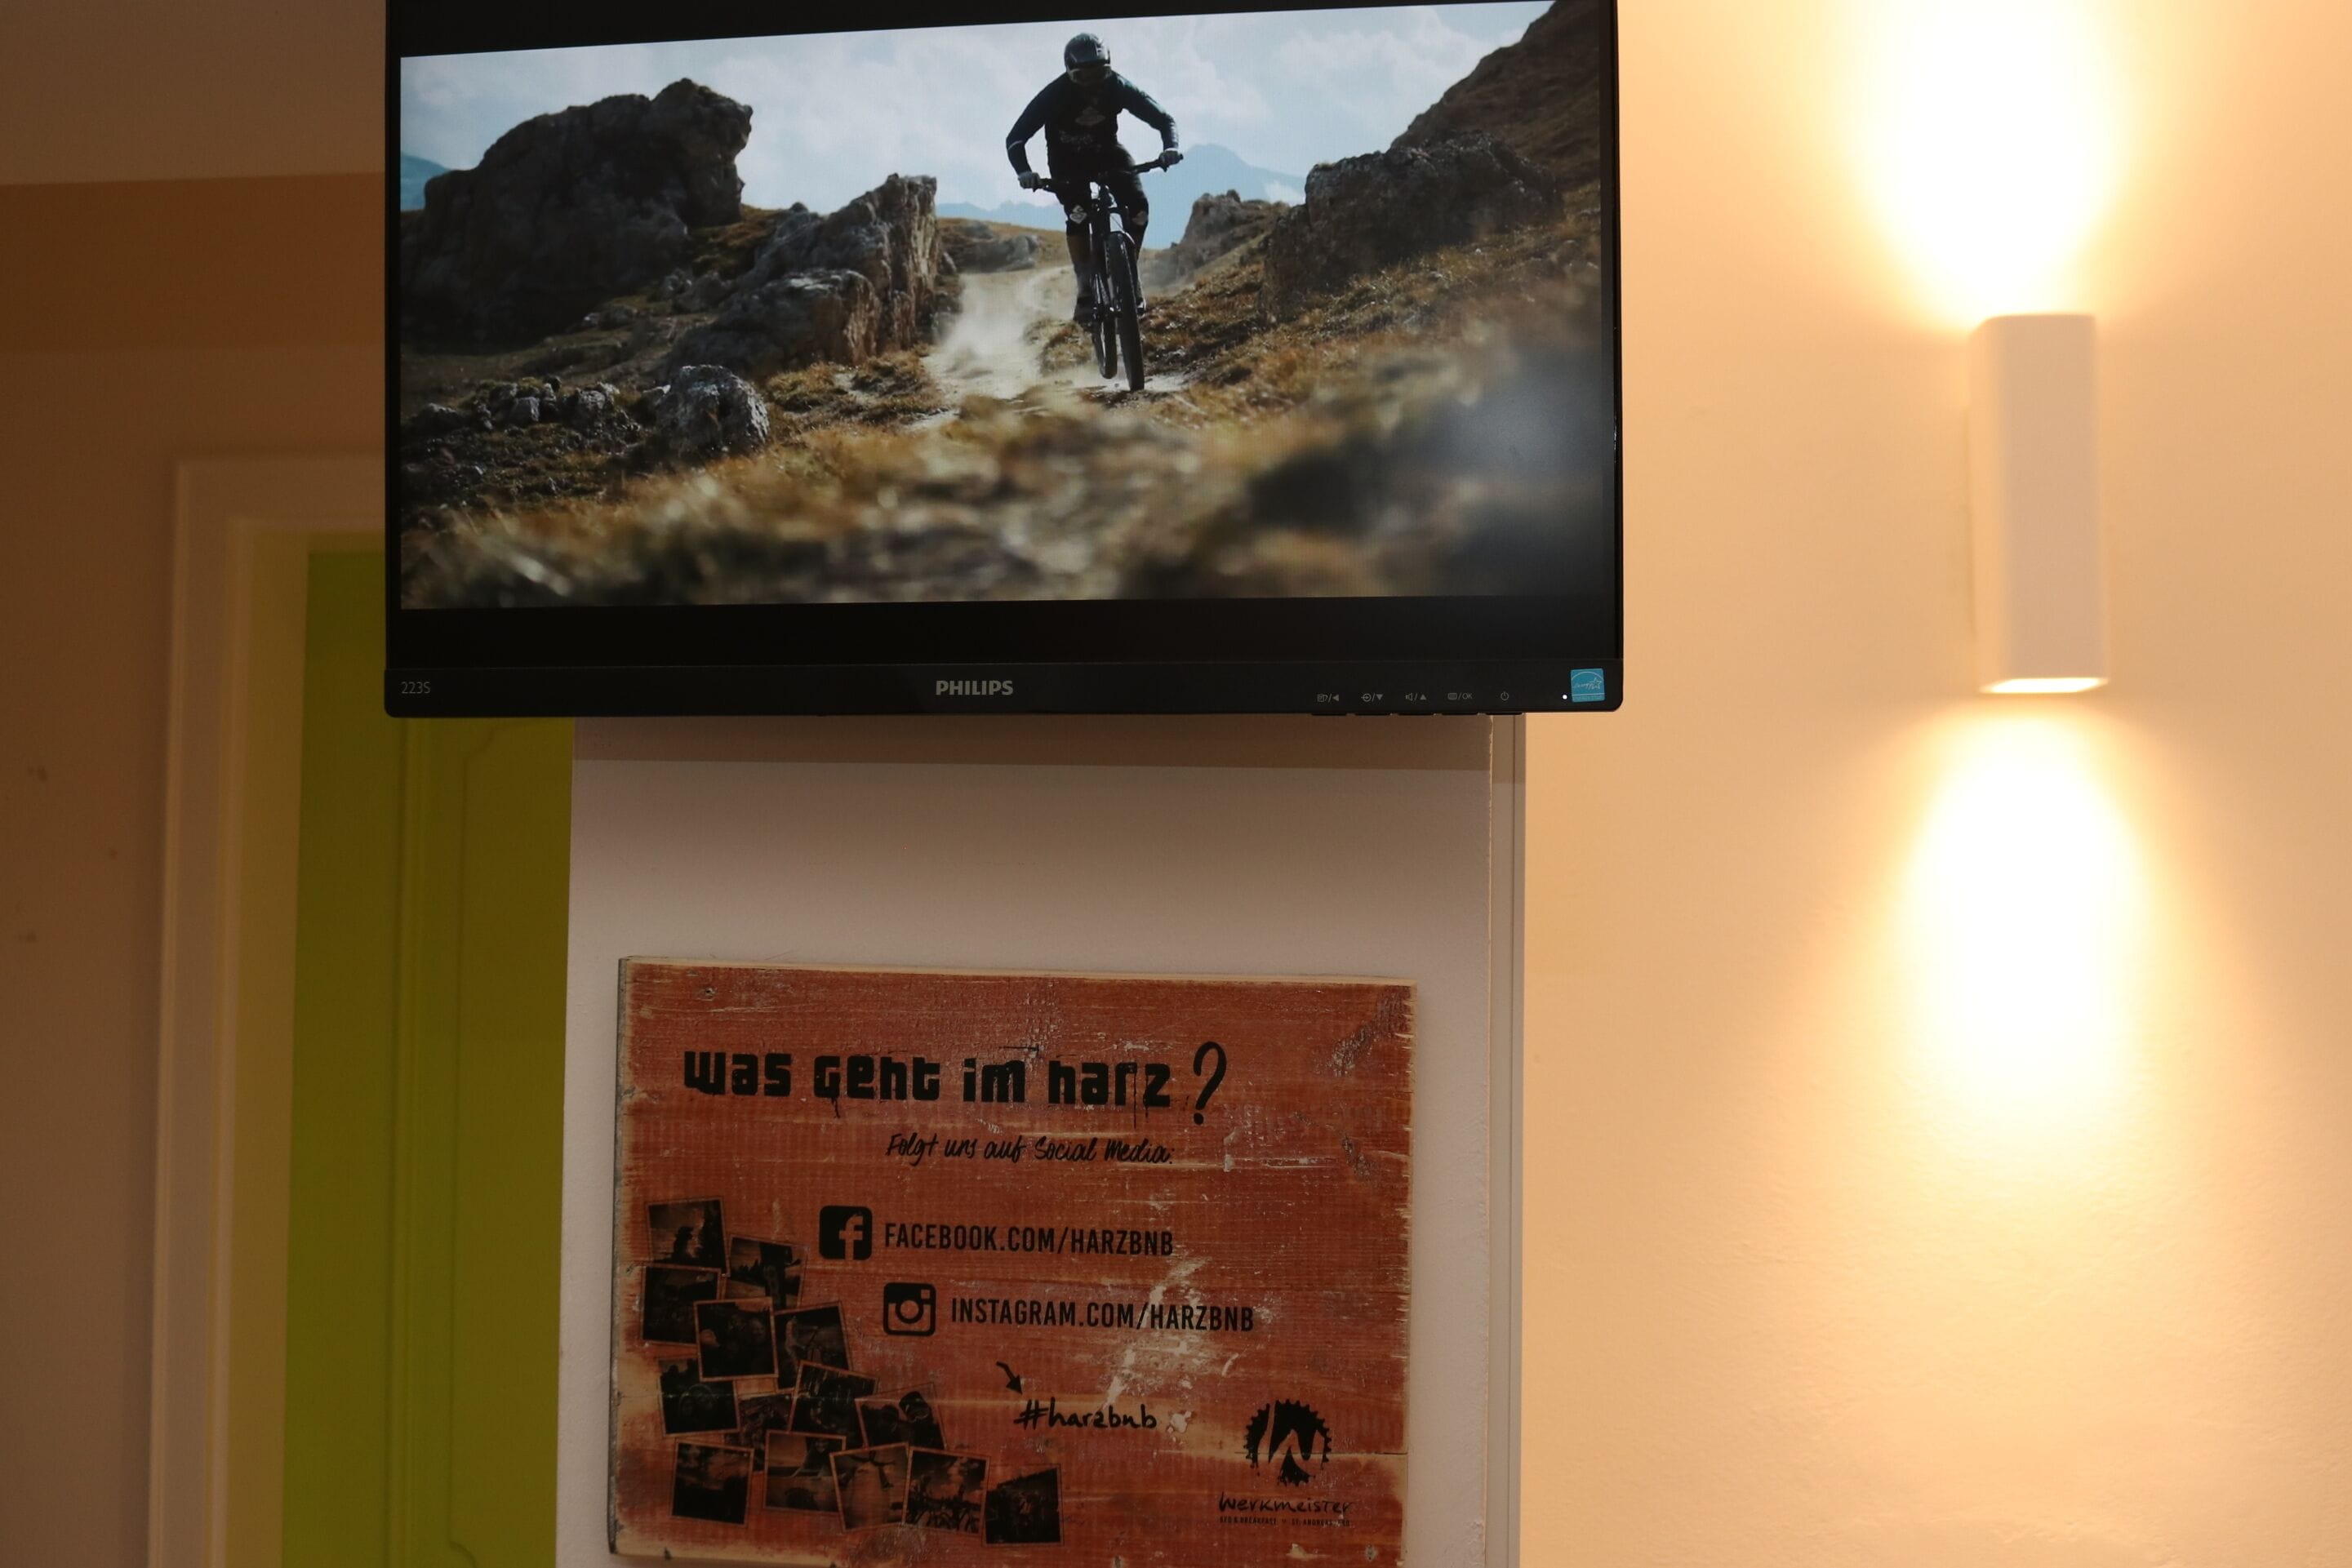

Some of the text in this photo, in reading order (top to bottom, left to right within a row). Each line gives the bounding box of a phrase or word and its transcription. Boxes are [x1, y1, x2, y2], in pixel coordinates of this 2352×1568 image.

[936, 680, 1014, 695] PHILIPS
[963, 1057, 1026, 1104] im
[1048, 1059, 1171, 1108] harz
[1193, 1041, 1227, 1126] ?
[886, 1133, 1175, 1167] Folgt uns auf Social Media:
[884, 1223, 1174, 1257] FACEBOOK.COM/HARZBNB
[951, 1297, 1254, 1332] INSTAGRAM.COM/HARZBNB
[1013, 1397, 1158, 1430] #harzbnb
